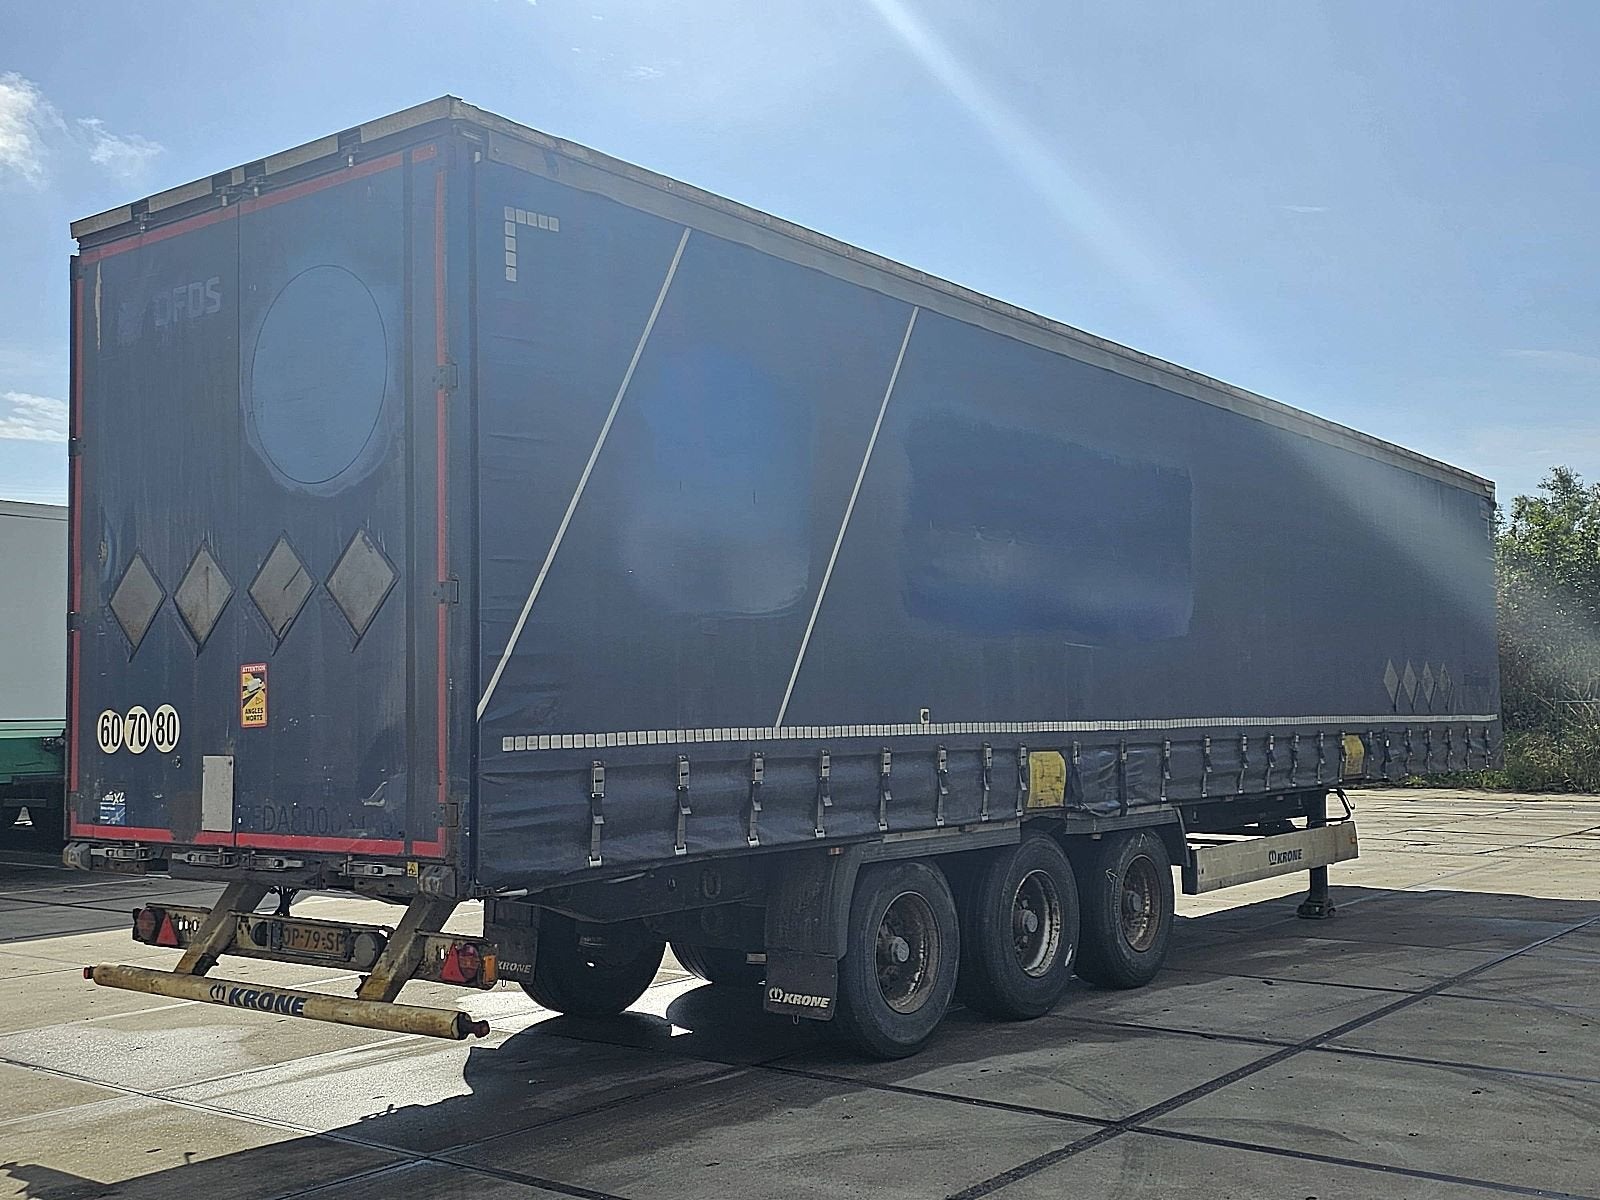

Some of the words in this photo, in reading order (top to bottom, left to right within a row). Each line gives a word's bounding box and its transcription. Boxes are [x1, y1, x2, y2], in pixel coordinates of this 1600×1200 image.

[245, 707, 264, 715] ANGLES
[245, 714, 263, 722] MORTS
[101, 714, 121, 748] 60
[128, 712, 148, 748] 70
[155, 711, 177, 747] 80
[1278, 849, 1302, 864] KRONE
[497, 960, 532, 974] KRONE
[229, 987, 307, 1015] KRONE
[783, 993, 830, 1008] KRONE
